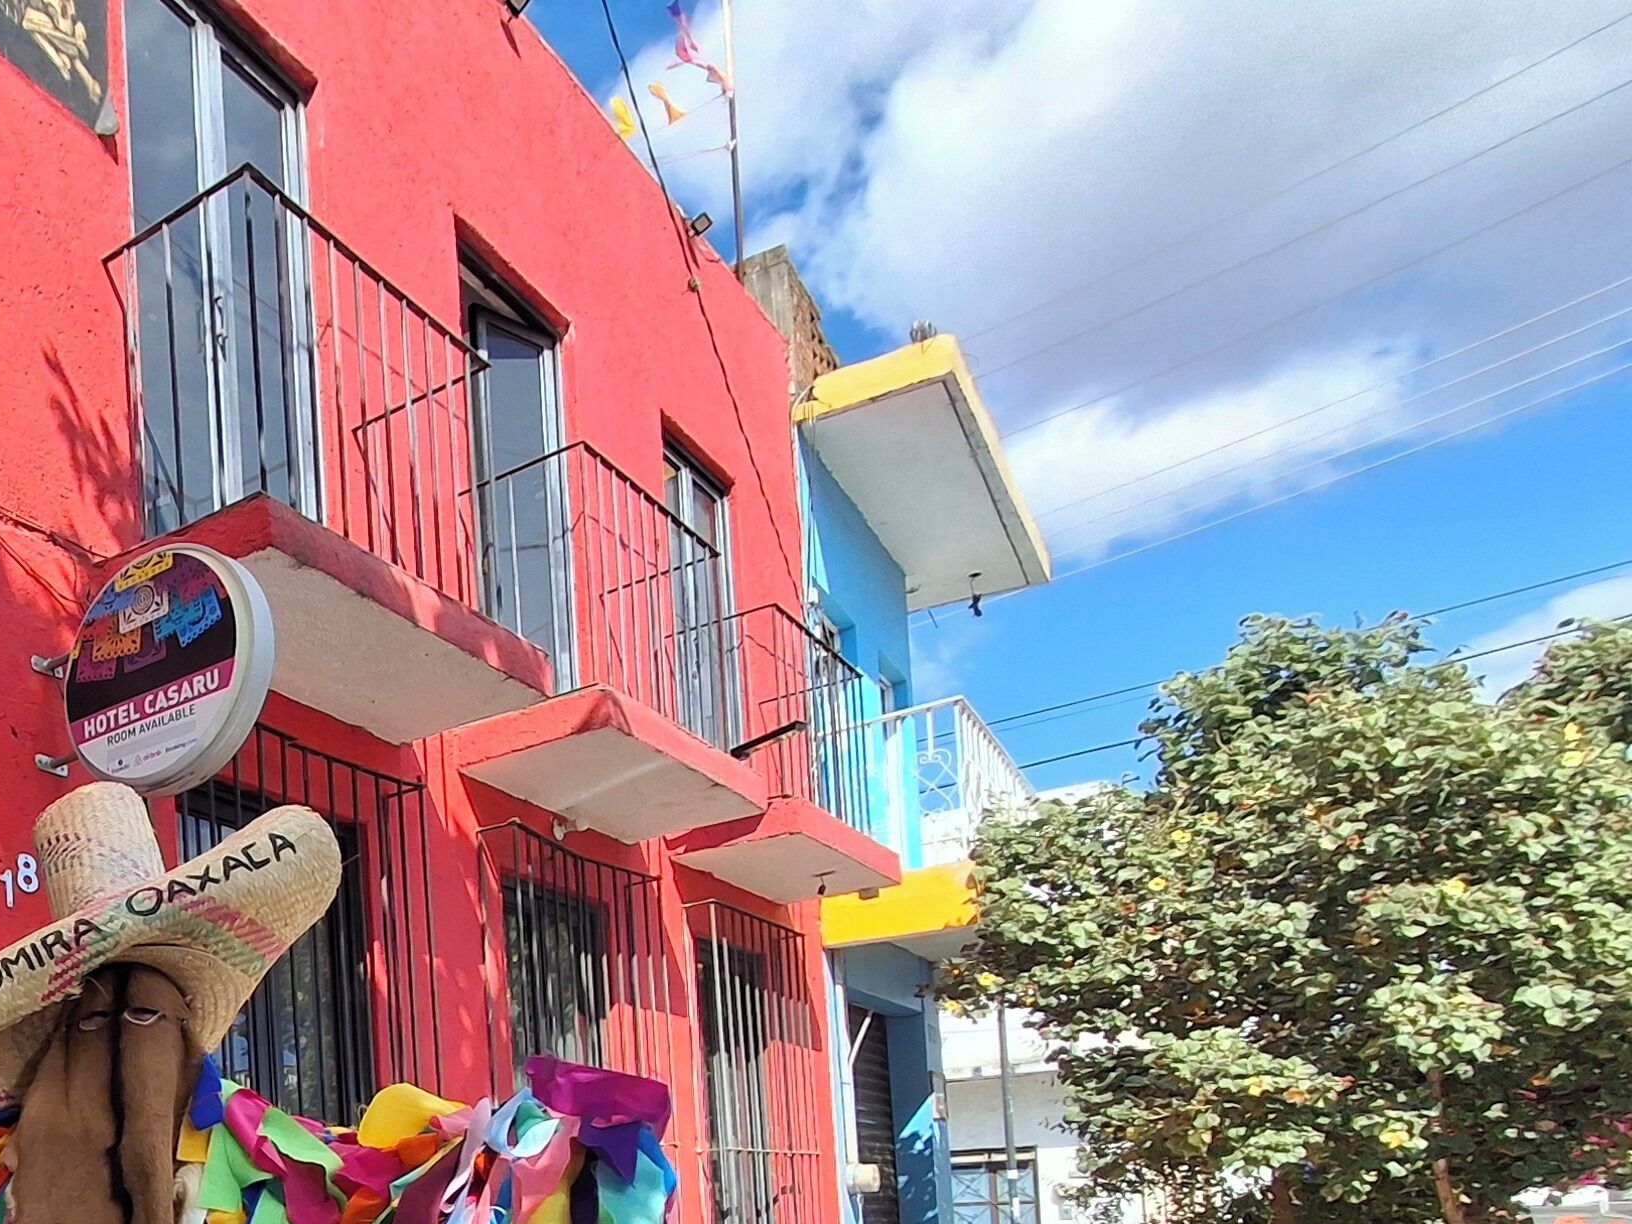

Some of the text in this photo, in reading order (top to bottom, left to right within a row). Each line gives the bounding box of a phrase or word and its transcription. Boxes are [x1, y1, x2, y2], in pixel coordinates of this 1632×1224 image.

[83, 668, 220, 740] HOTEL CASARU
[106, 704, 197, 747] ROOM AVAILABLE
[125, 832, 298, 917] OAXACA
